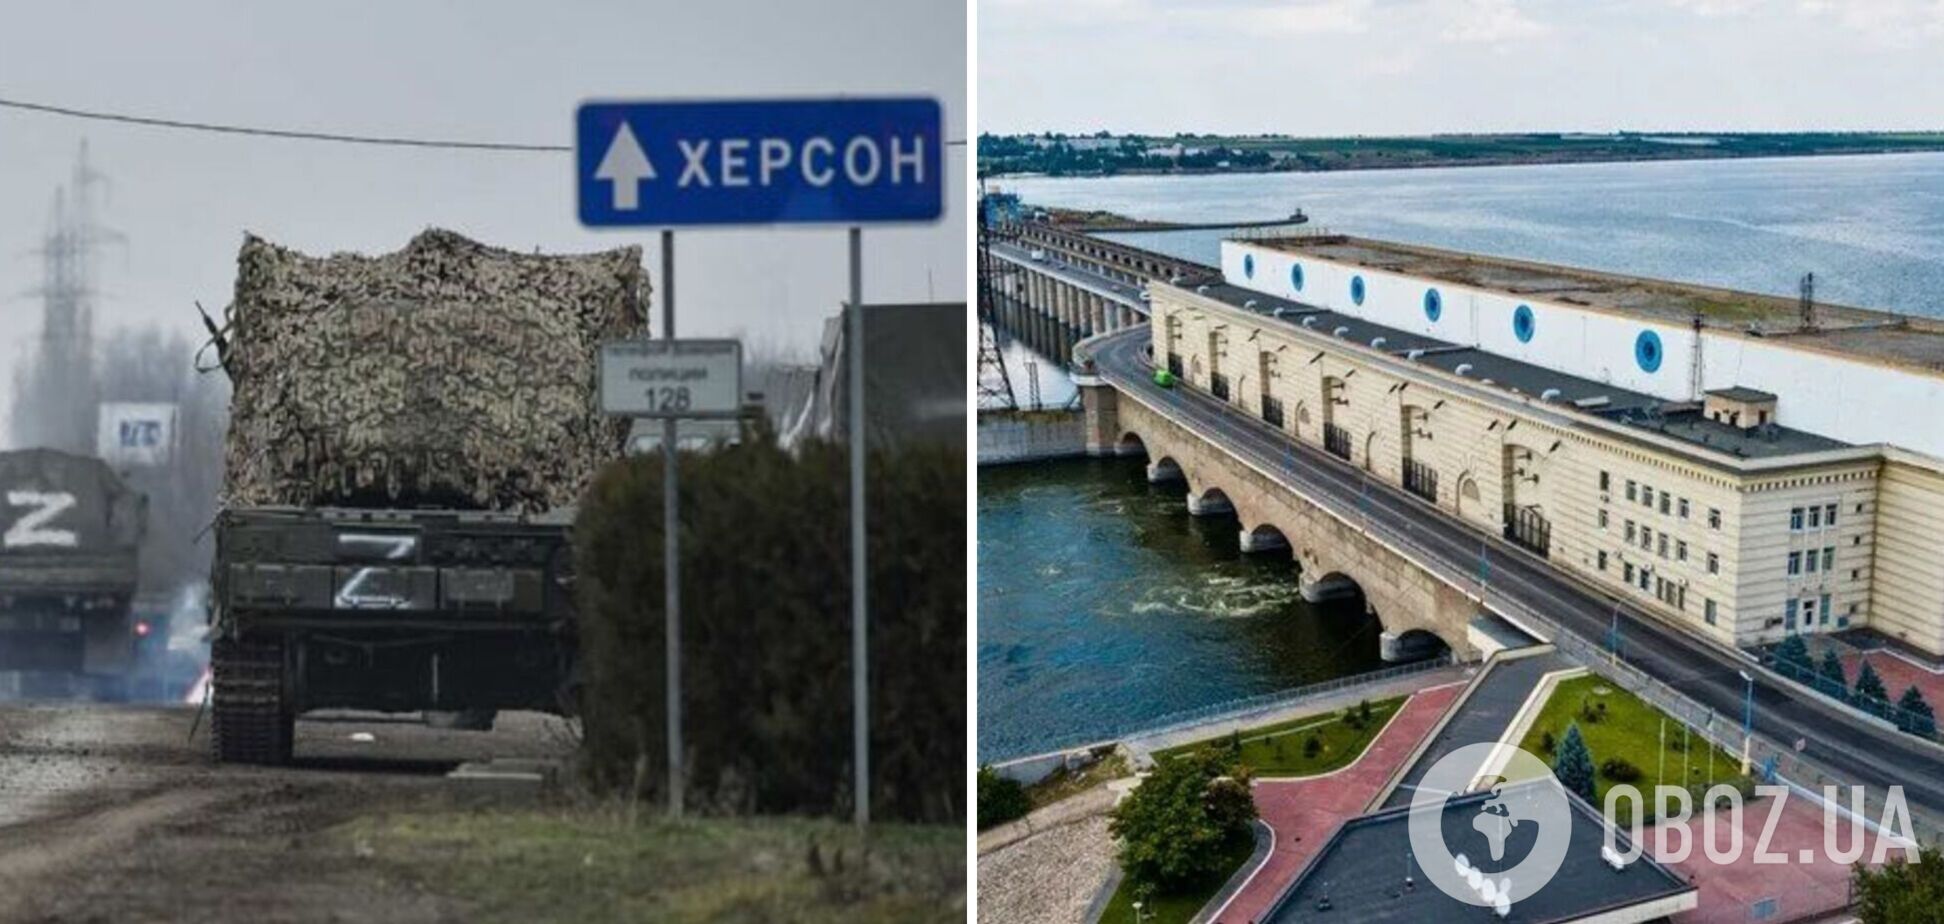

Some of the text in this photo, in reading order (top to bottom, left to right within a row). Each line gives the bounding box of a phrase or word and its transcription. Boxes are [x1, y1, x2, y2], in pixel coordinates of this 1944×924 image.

[678, 137, 925, 187] ХЕРСОН
[645, 387, 691, 411] 128
[4, 491, 78, 546] Z
[336, 535, 416, 609] Z
